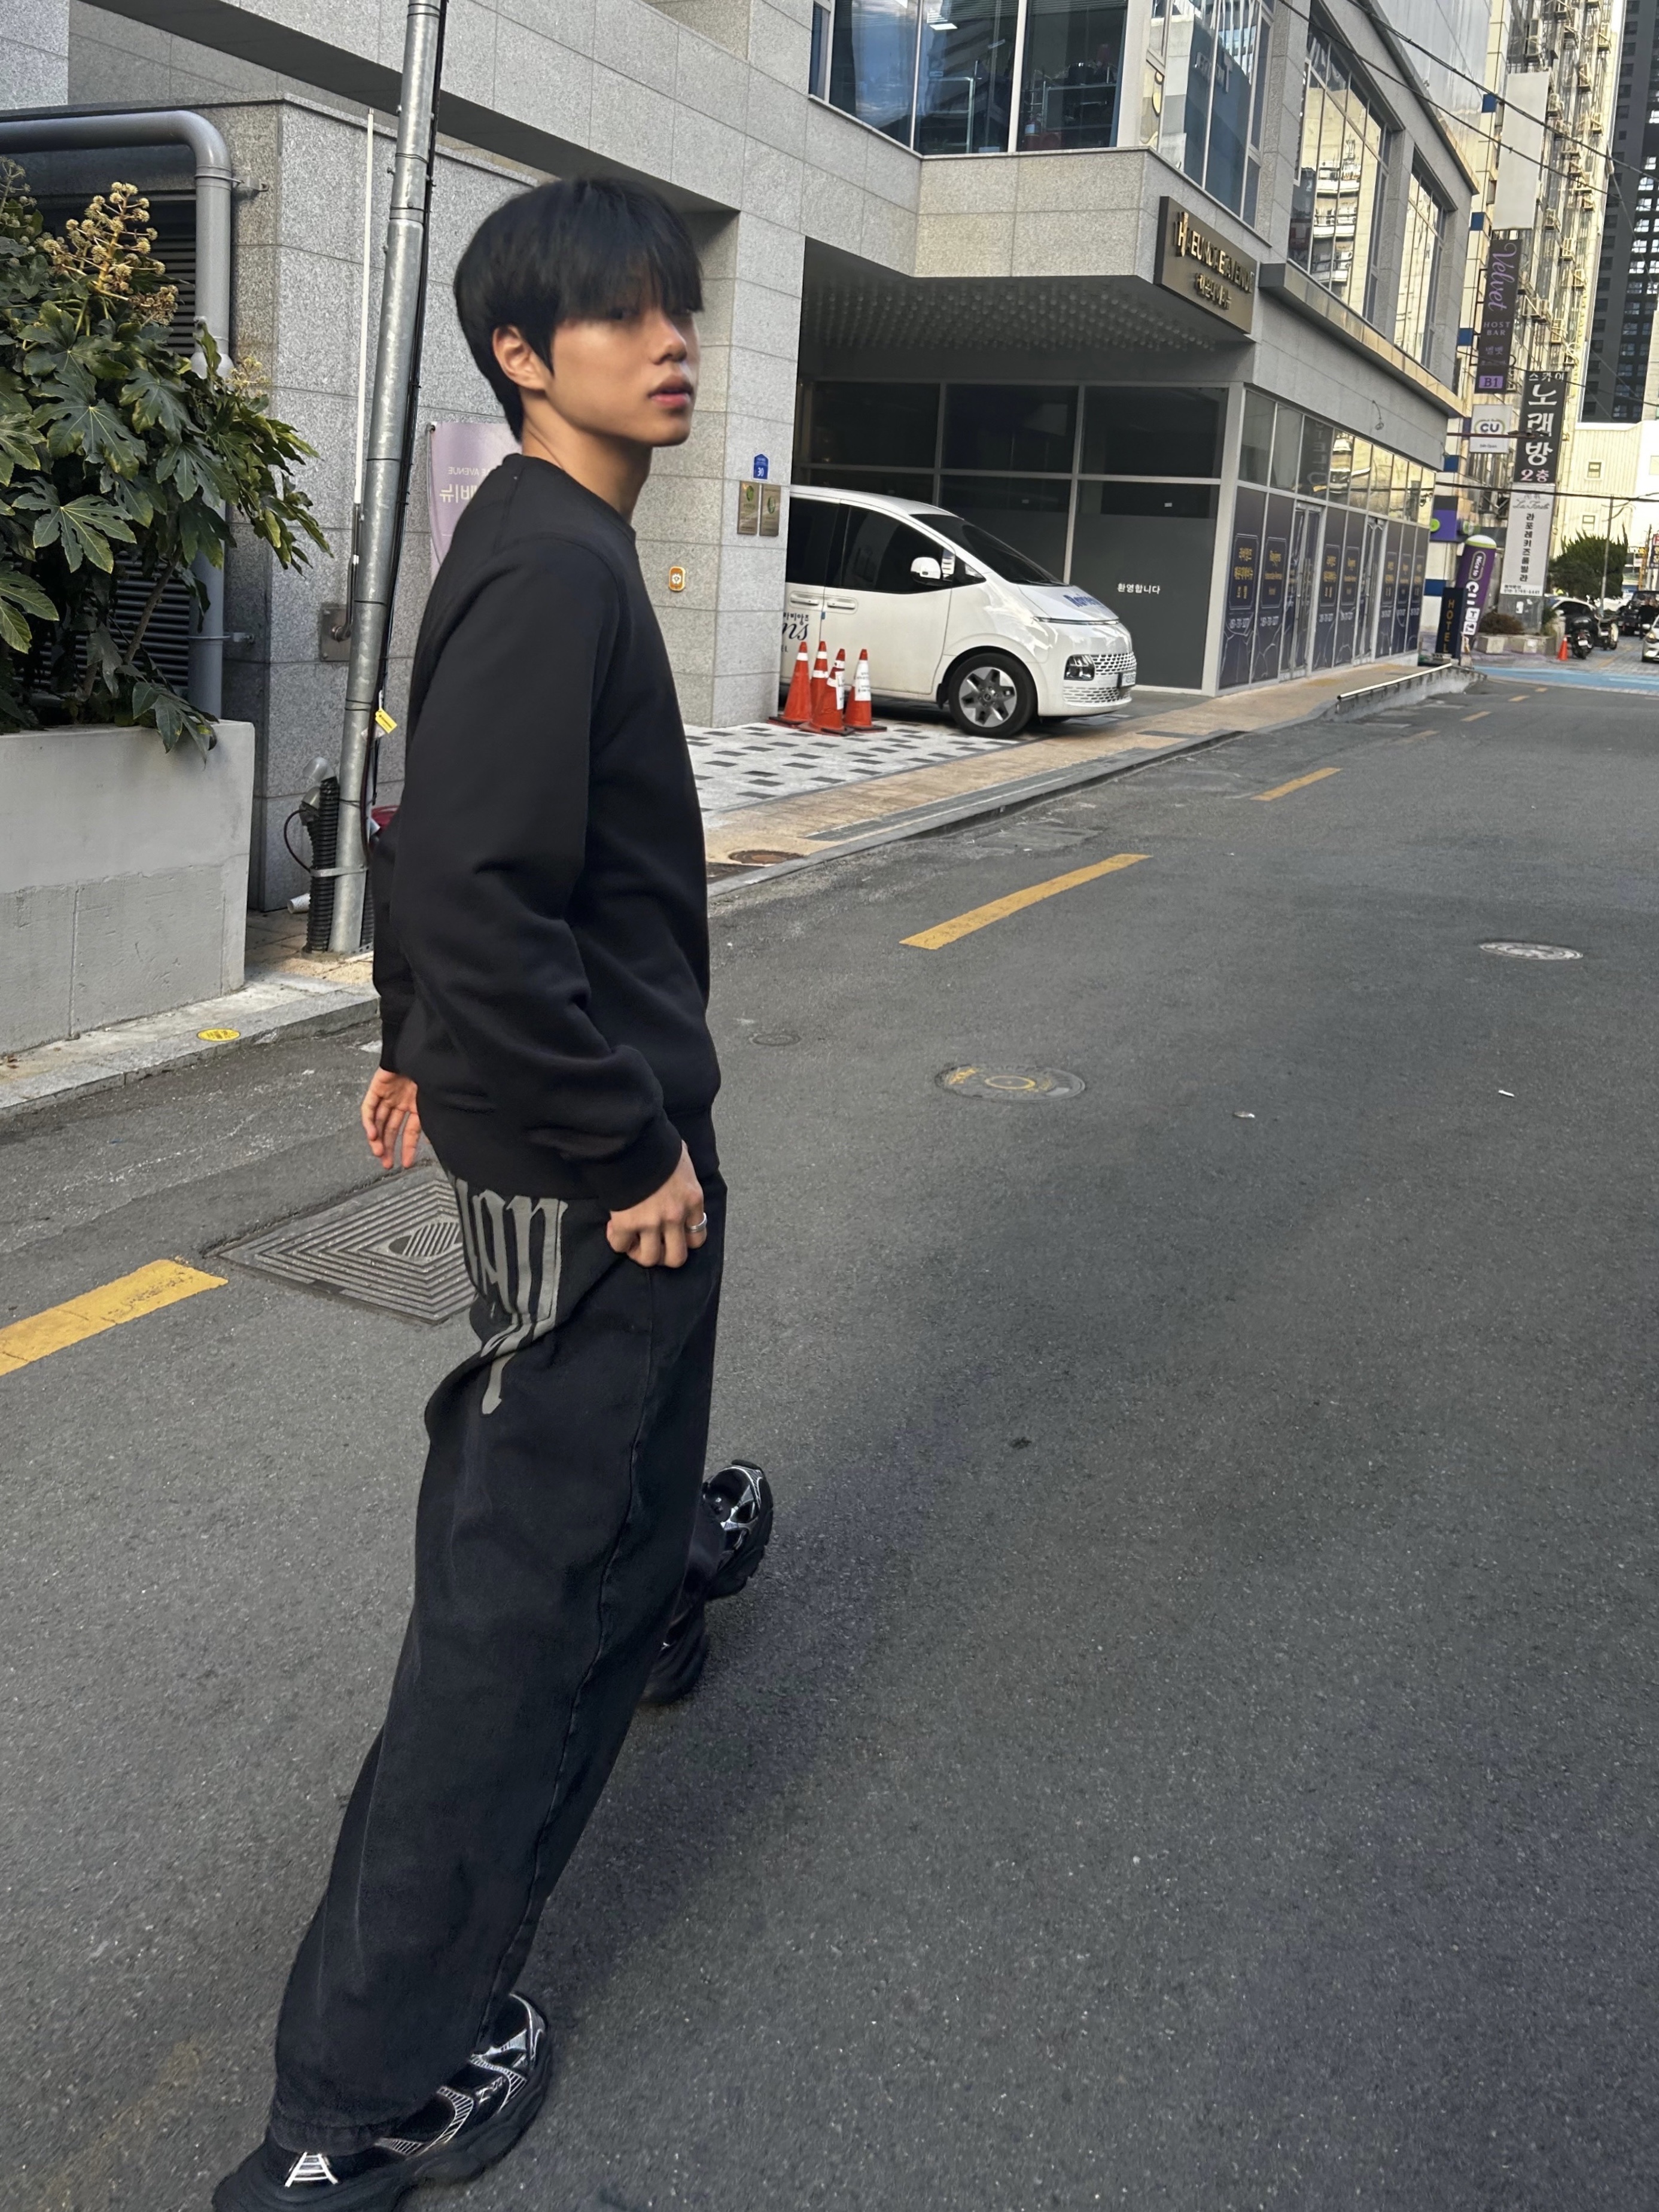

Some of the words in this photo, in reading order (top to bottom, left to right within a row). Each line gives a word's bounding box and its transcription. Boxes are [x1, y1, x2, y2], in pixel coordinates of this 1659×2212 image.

[1488, 242, 1517, 312] Velvet
[1484, 377, 1499, 388] B1
[1529, 372, 1564, 382] 스카이
[1480, 423, 1500, 433] CU
[1526, 384, 1557, 466] 노래방
[757, 467, 765, 477] 30
[1520, 469, 1549, 483] 2층
[1474, 556, 1483, 570] Nice
[1118, 583, 1161, 595] 환영합니다
[1444, 600, 1455, 653] HOTEL
